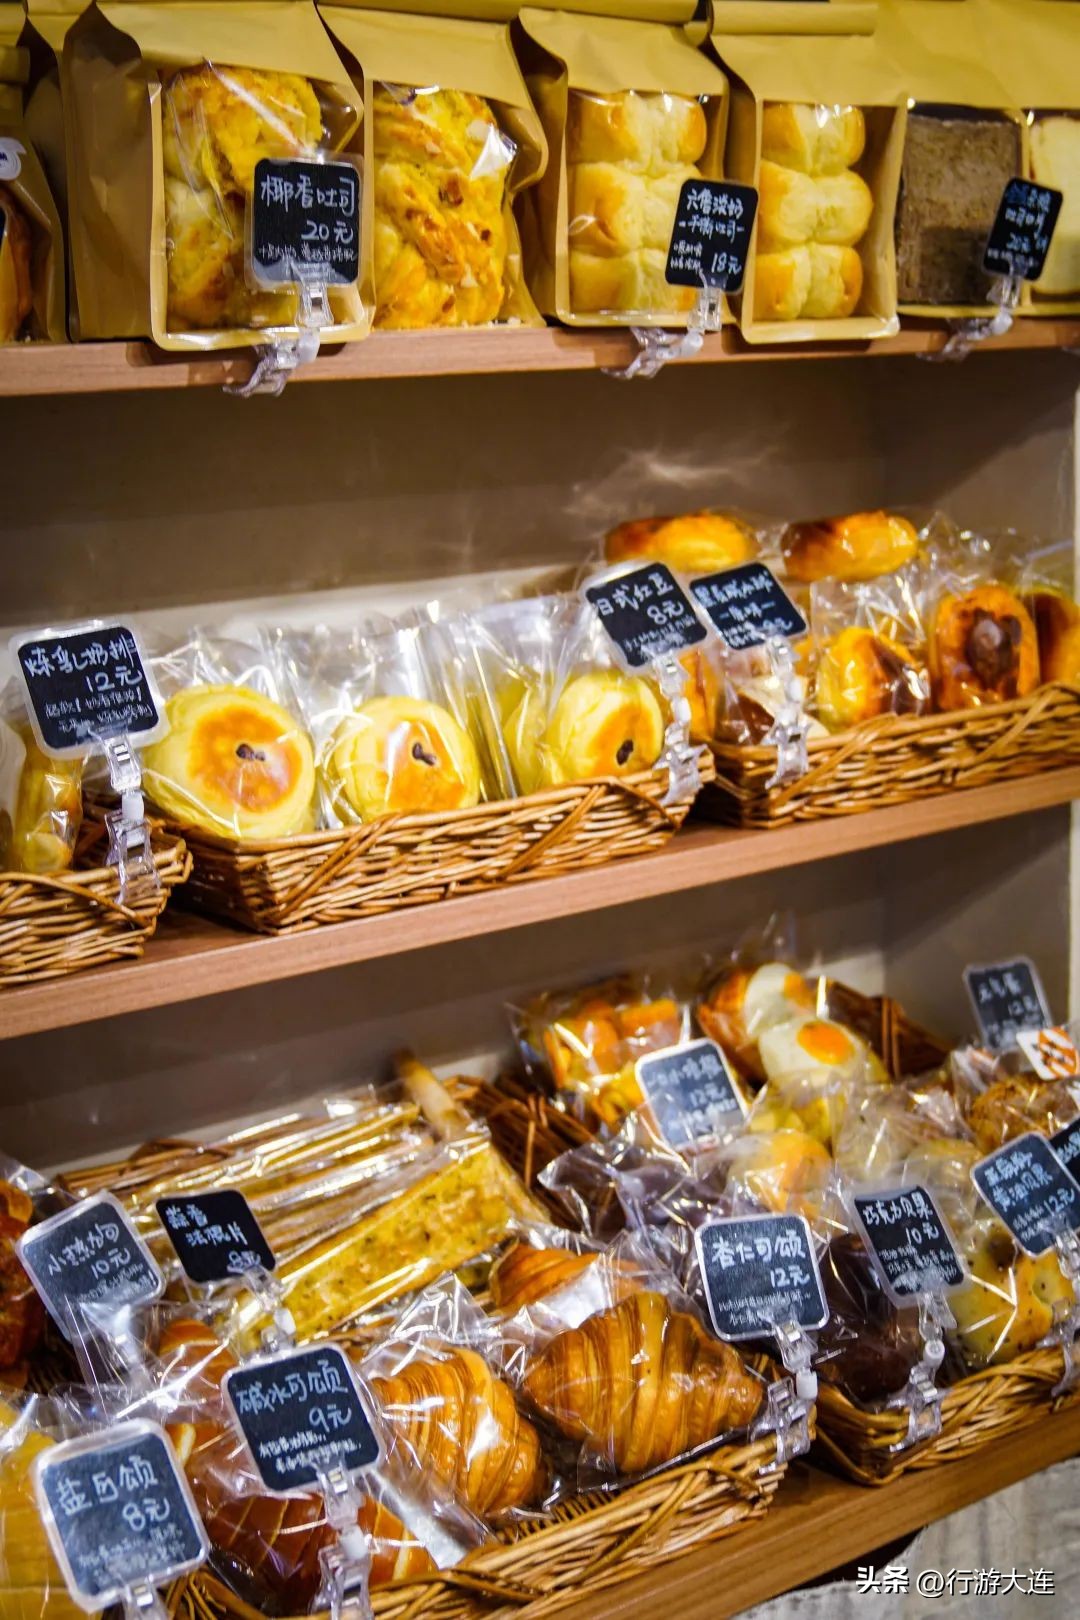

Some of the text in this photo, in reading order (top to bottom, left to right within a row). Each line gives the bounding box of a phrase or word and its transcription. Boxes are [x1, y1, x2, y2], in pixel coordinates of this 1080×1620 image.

[261, 173, 355, 217] 椰香吐司
[301, 220, 354, 244] 20元
[711, 252, 743, 275] 18元
[597, 572, 674, 616] 日式红豆
[646, 600, 685, 625] 8元
[24, 633, 138, 678] 炼乳奶排
[86, 664, 143, 693] 12元
[862, 1191, 933, 1226] 巧克力贝果
[1043, 1187, 1075, 1217] 12元
[711, 1229, 807, 1271] 杏仁可颂
[905, 1221, 939, 1246] 10元
[90, 1247, 132, 1280] 10元
[769, 1265, 810, 1289] 12元
[236, 1359, 349, 1415] 碱水可颂
[308, 1403, 353, 1432] 9元
[56, 1454, 159, 1517] 盐可颂
[122, 1497, 171, 1533] 8元
